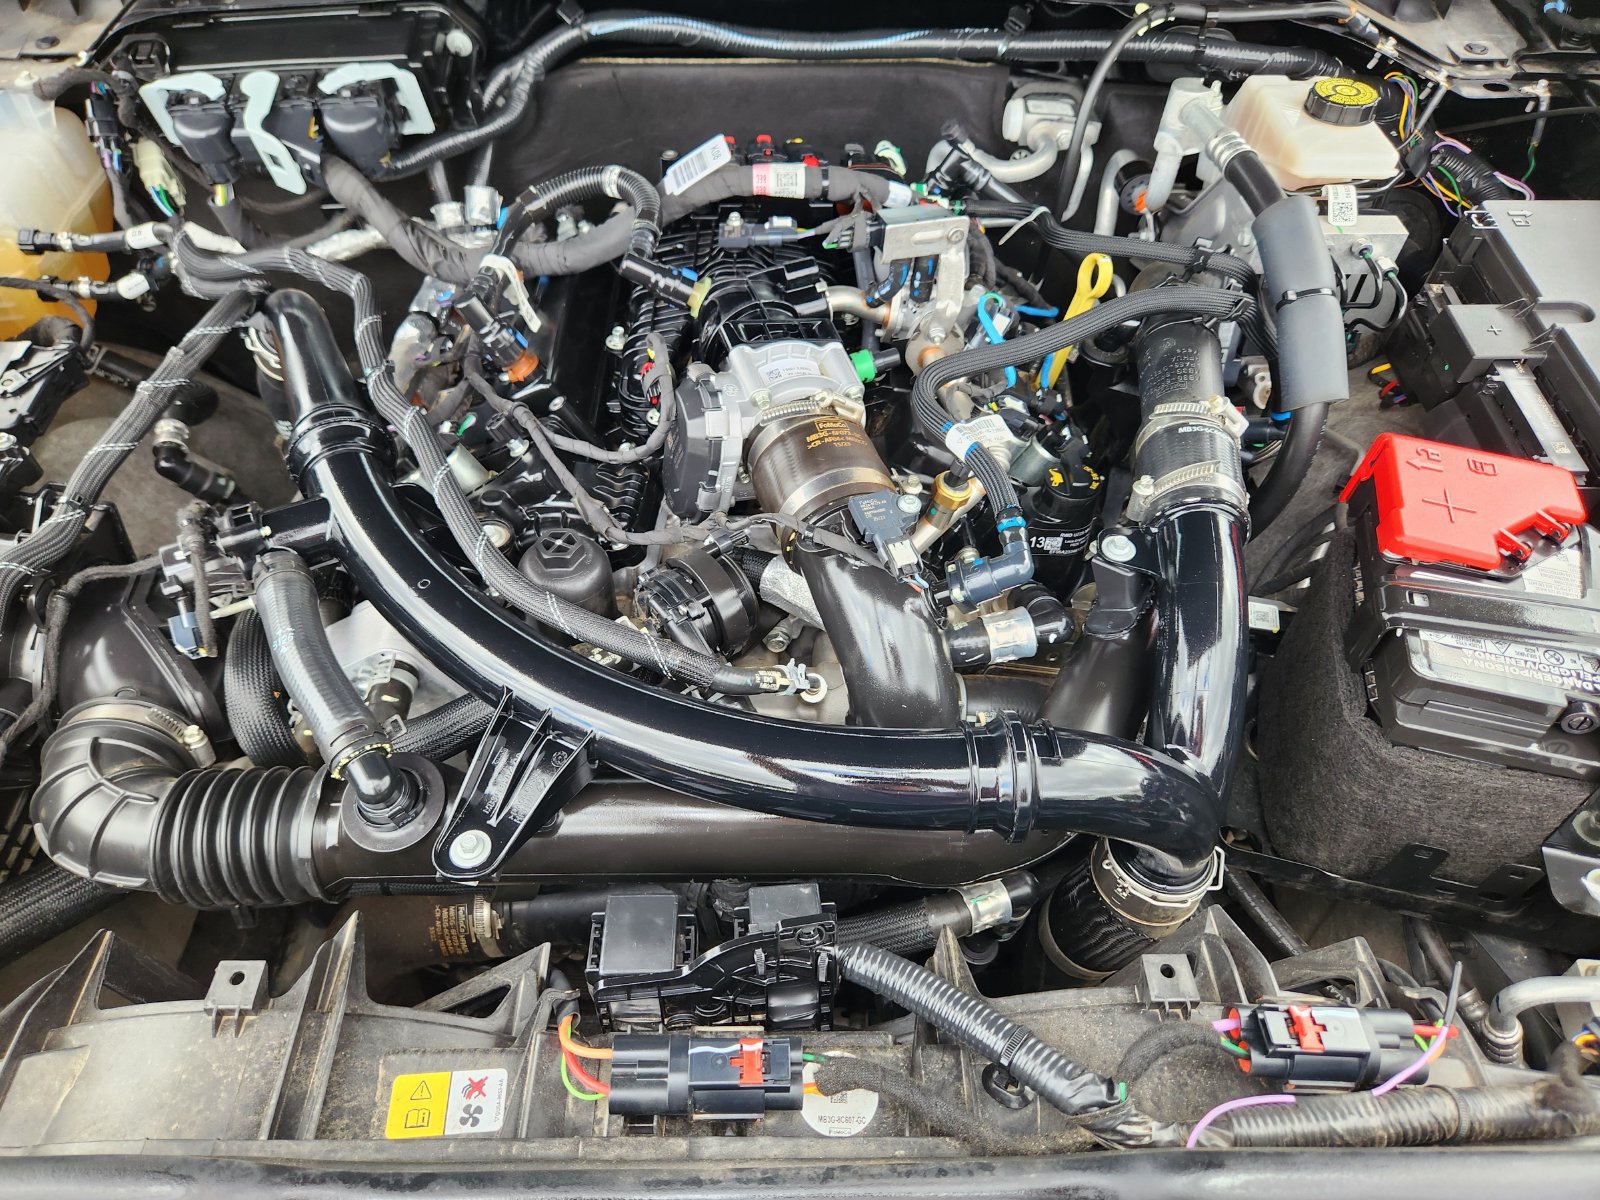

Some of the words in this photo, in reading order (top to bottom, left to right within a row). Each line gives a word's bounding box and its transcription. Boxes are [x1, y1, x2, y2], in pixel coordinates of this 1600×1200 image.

[1030, 536, 1046, 549] 13
[1474, 661, 1594, 690] DANGER/POISON
[457, 906, 467, 933] FoMoCo
